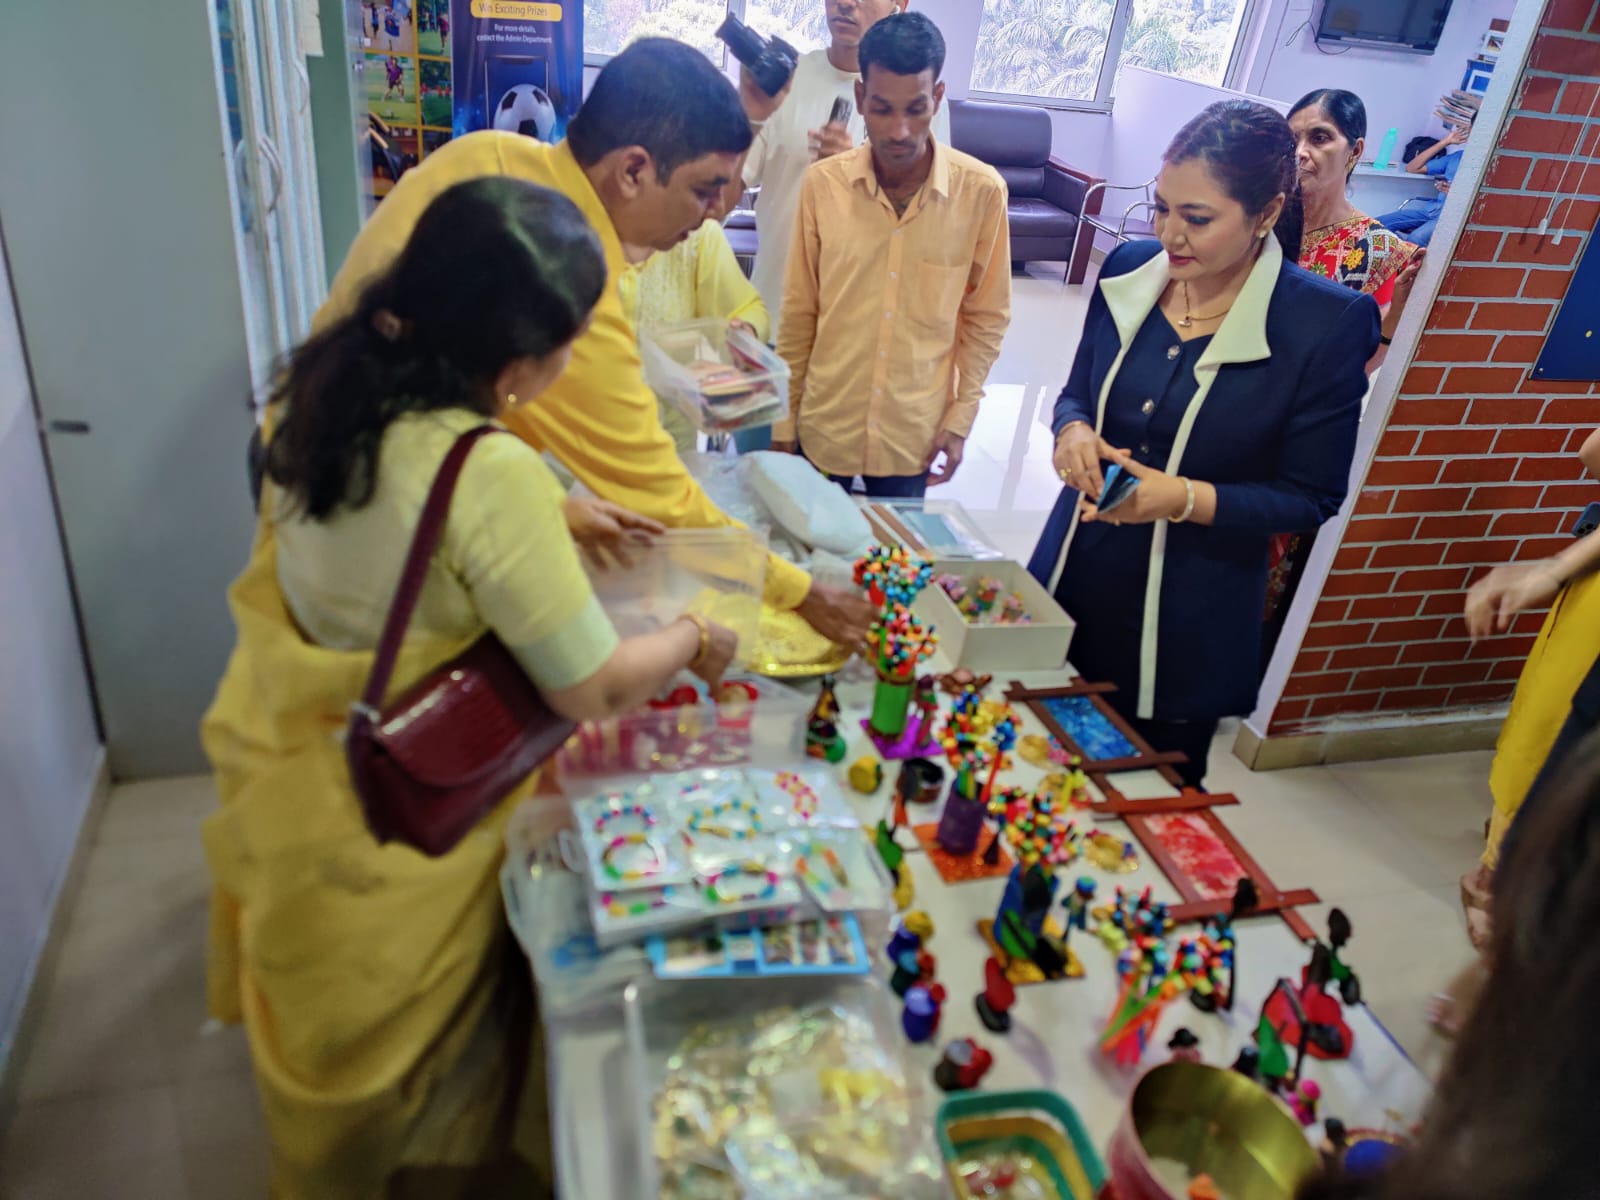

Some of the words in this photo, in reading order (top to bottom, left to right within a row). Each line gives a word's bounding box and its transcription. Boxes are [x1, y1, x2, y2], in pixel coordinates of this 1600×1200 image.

[495, 3, 526, 17] Exciting
[527, 5, 549, 17] Prizes
[494, 23, 504, 32] For
[496, 34, 504, 42] the
[505, 34, 522, 42] Admin
